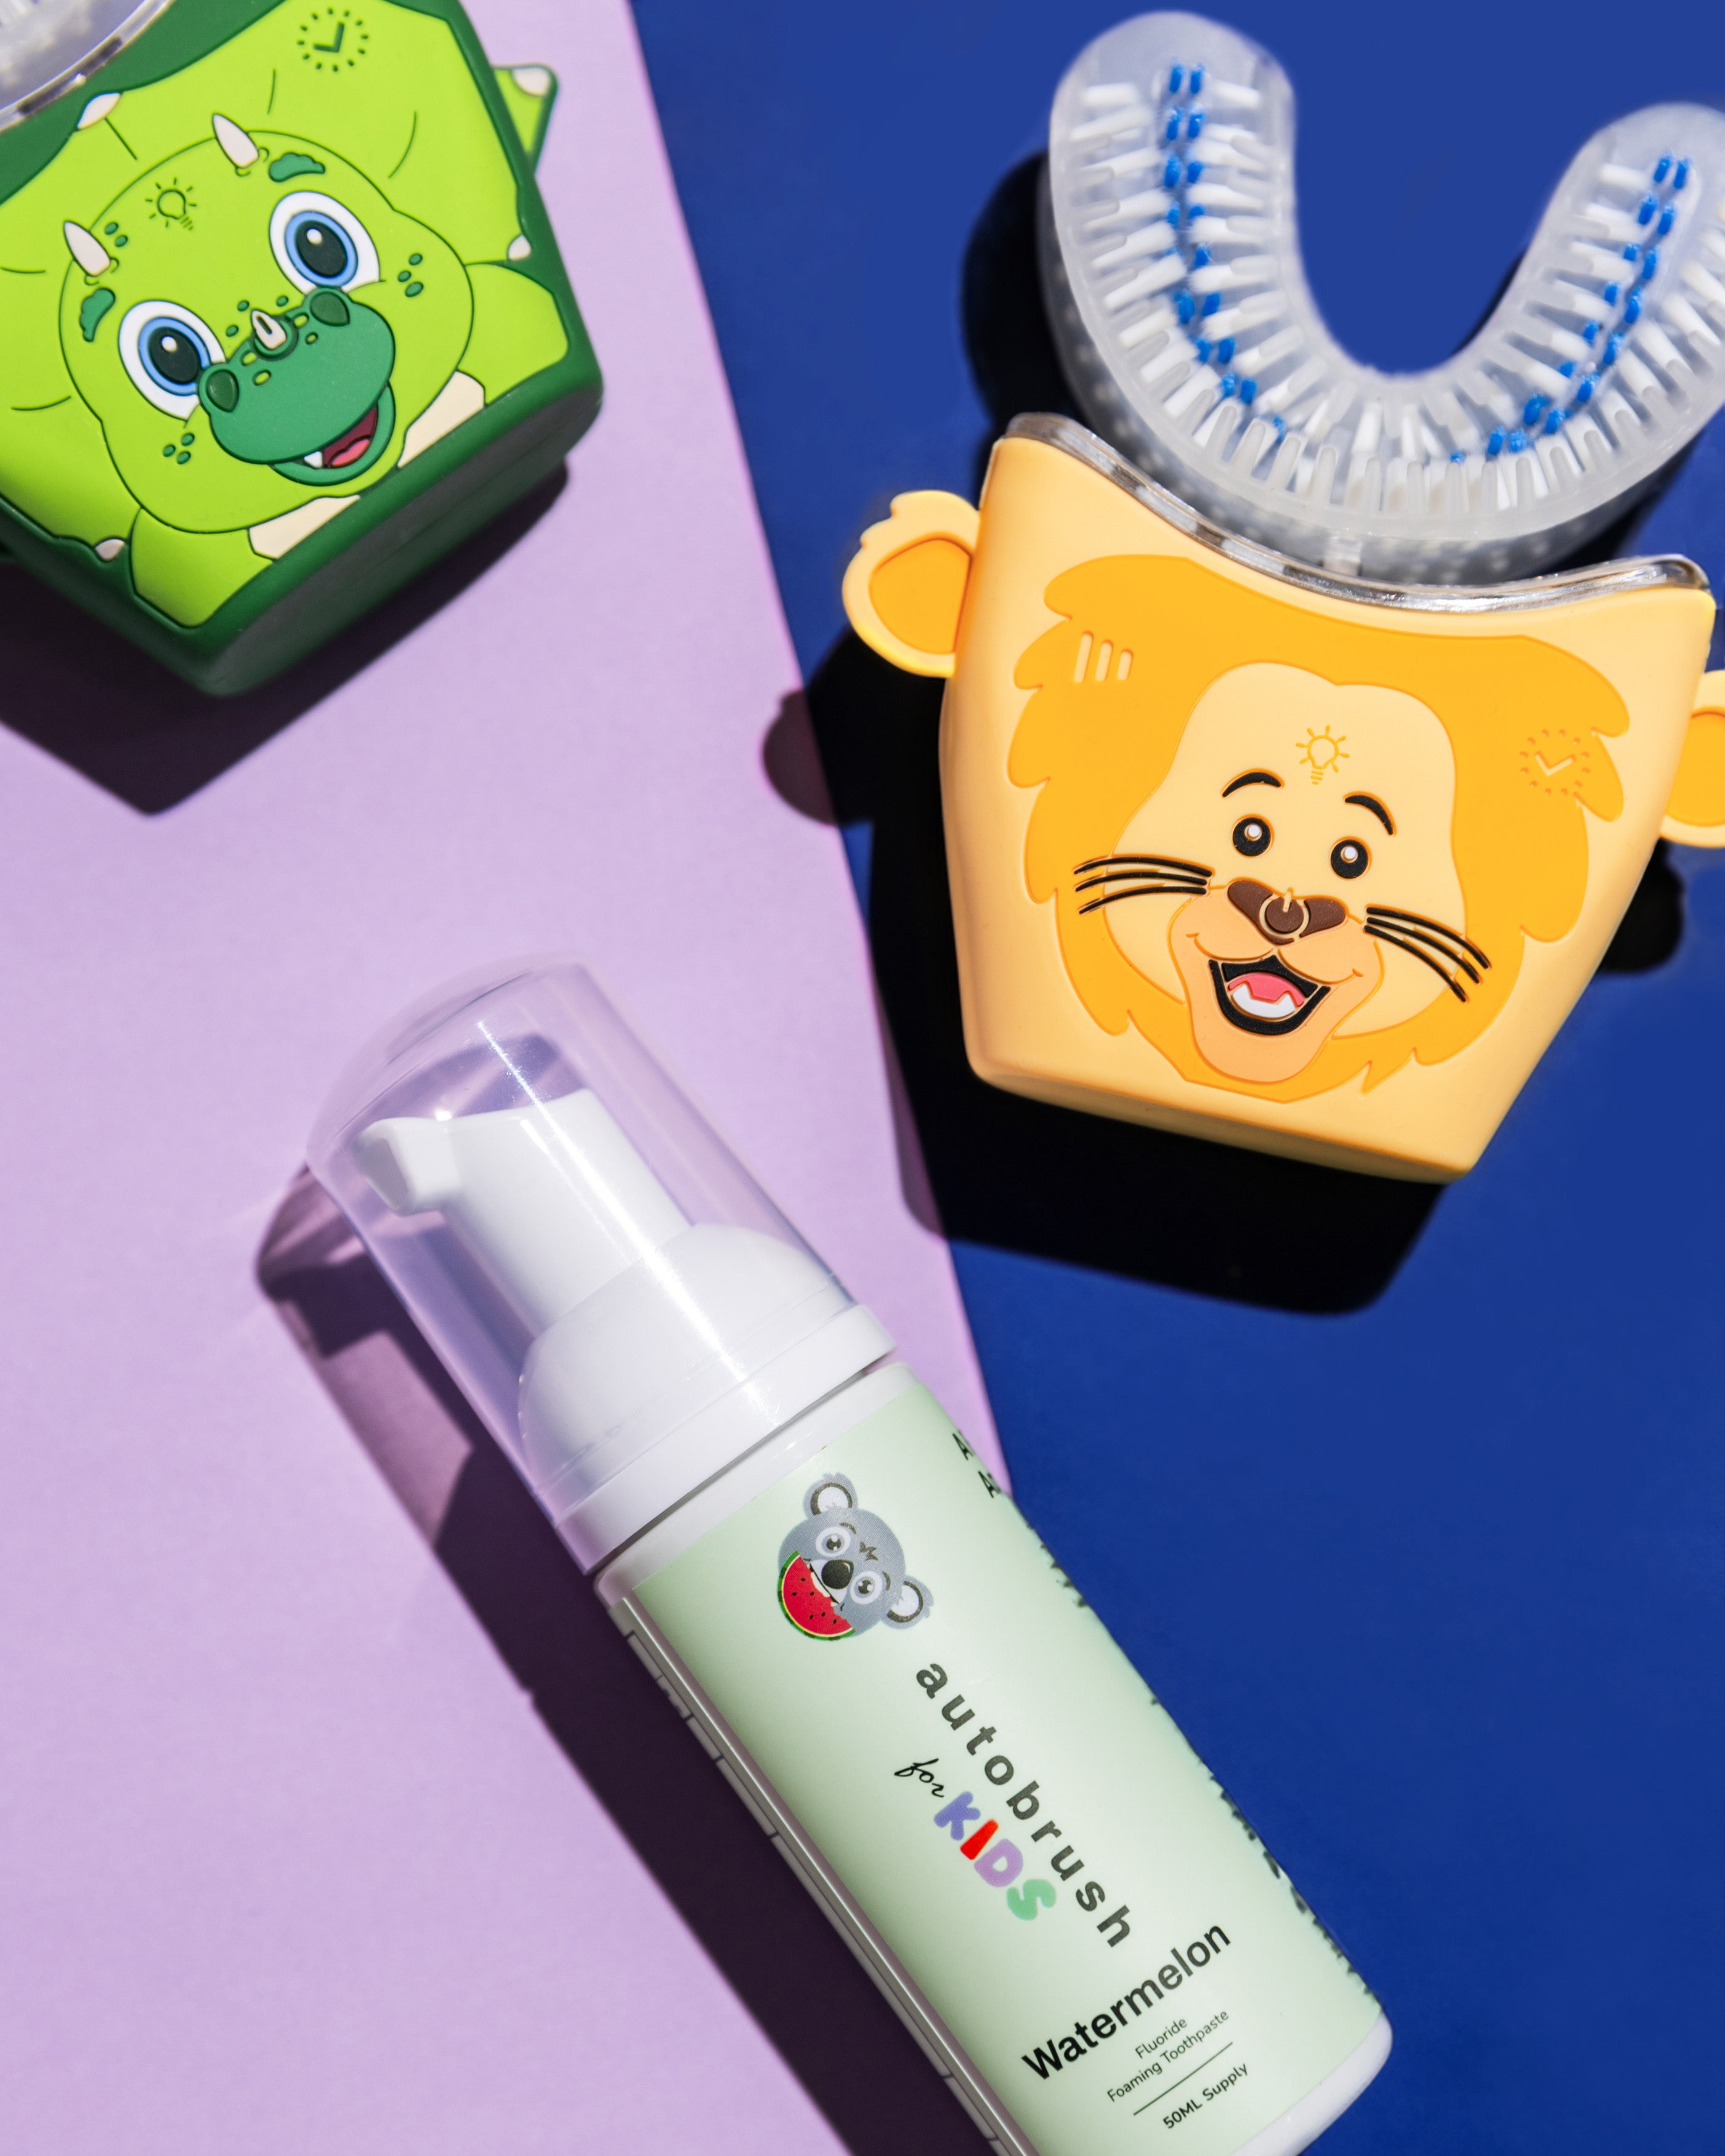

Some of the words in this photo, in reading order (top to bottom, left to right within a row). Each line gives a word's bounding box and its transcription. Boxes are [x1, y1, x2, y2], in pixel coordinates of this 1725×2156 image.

[893, 1757, 944, 1798] for
[934, 1791, 1055, 1919] KIDS
[915, 1663, 1130, 1948] autobrush
[1021, 1925, 1231, 2080] Watermelon
[1106, 2062, 1163, 2102] Foaming
[1159, 2011, 1229, 2063] Toothpaste
[1135, 2019, 1187, 2059] Fluoride
[1163, 2099, 1203, 2129] 50ML
[1202, 2064, 1248, 2101] Supply
